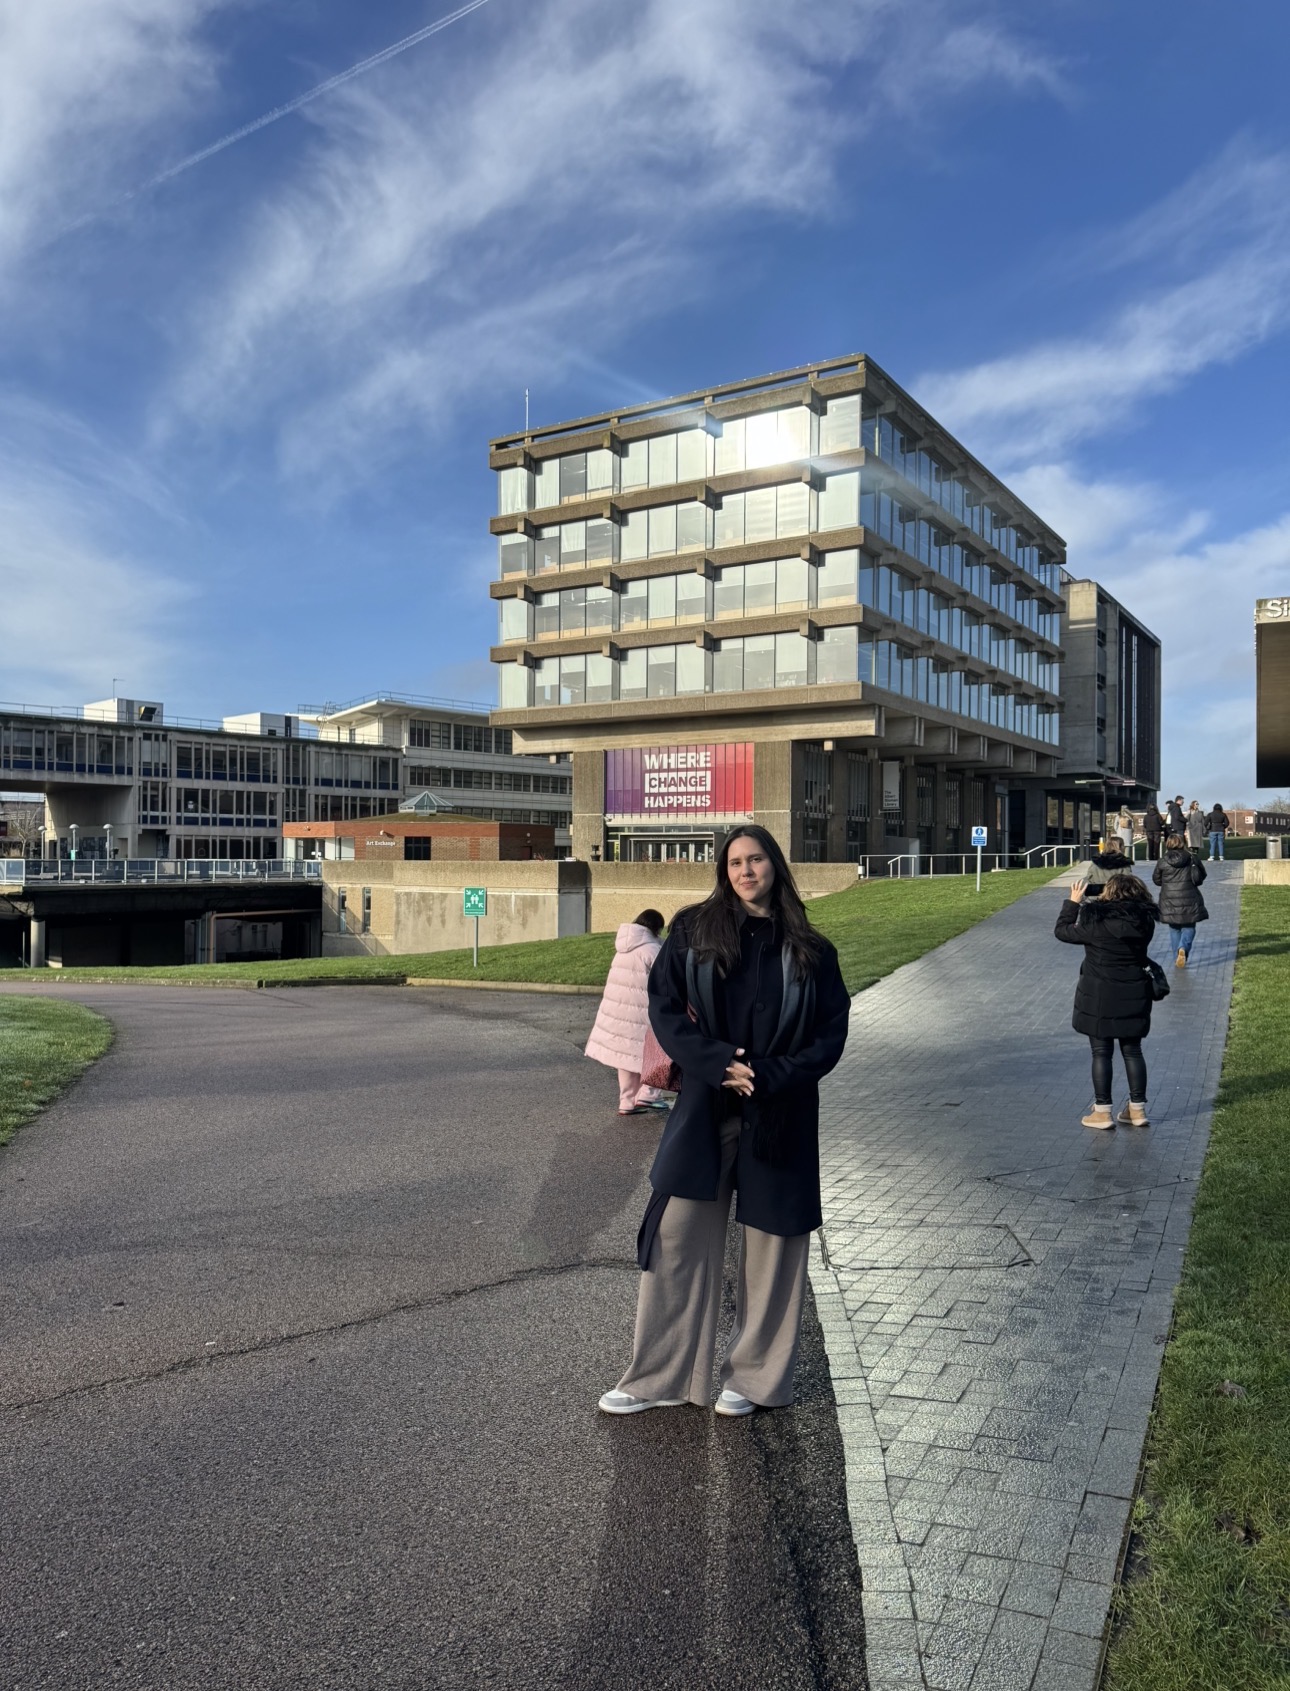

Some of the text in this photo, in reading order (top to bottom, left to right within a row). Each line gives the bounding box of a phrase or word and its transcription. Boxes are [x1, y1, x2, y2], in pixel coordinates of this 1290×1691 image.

[1266, 599, 1290, 618] Si
[644, 752, 711, 769] WHERE
[649, 776, 707, 788] CHANGE
[644, 795, 711, 808] HAPPENS
